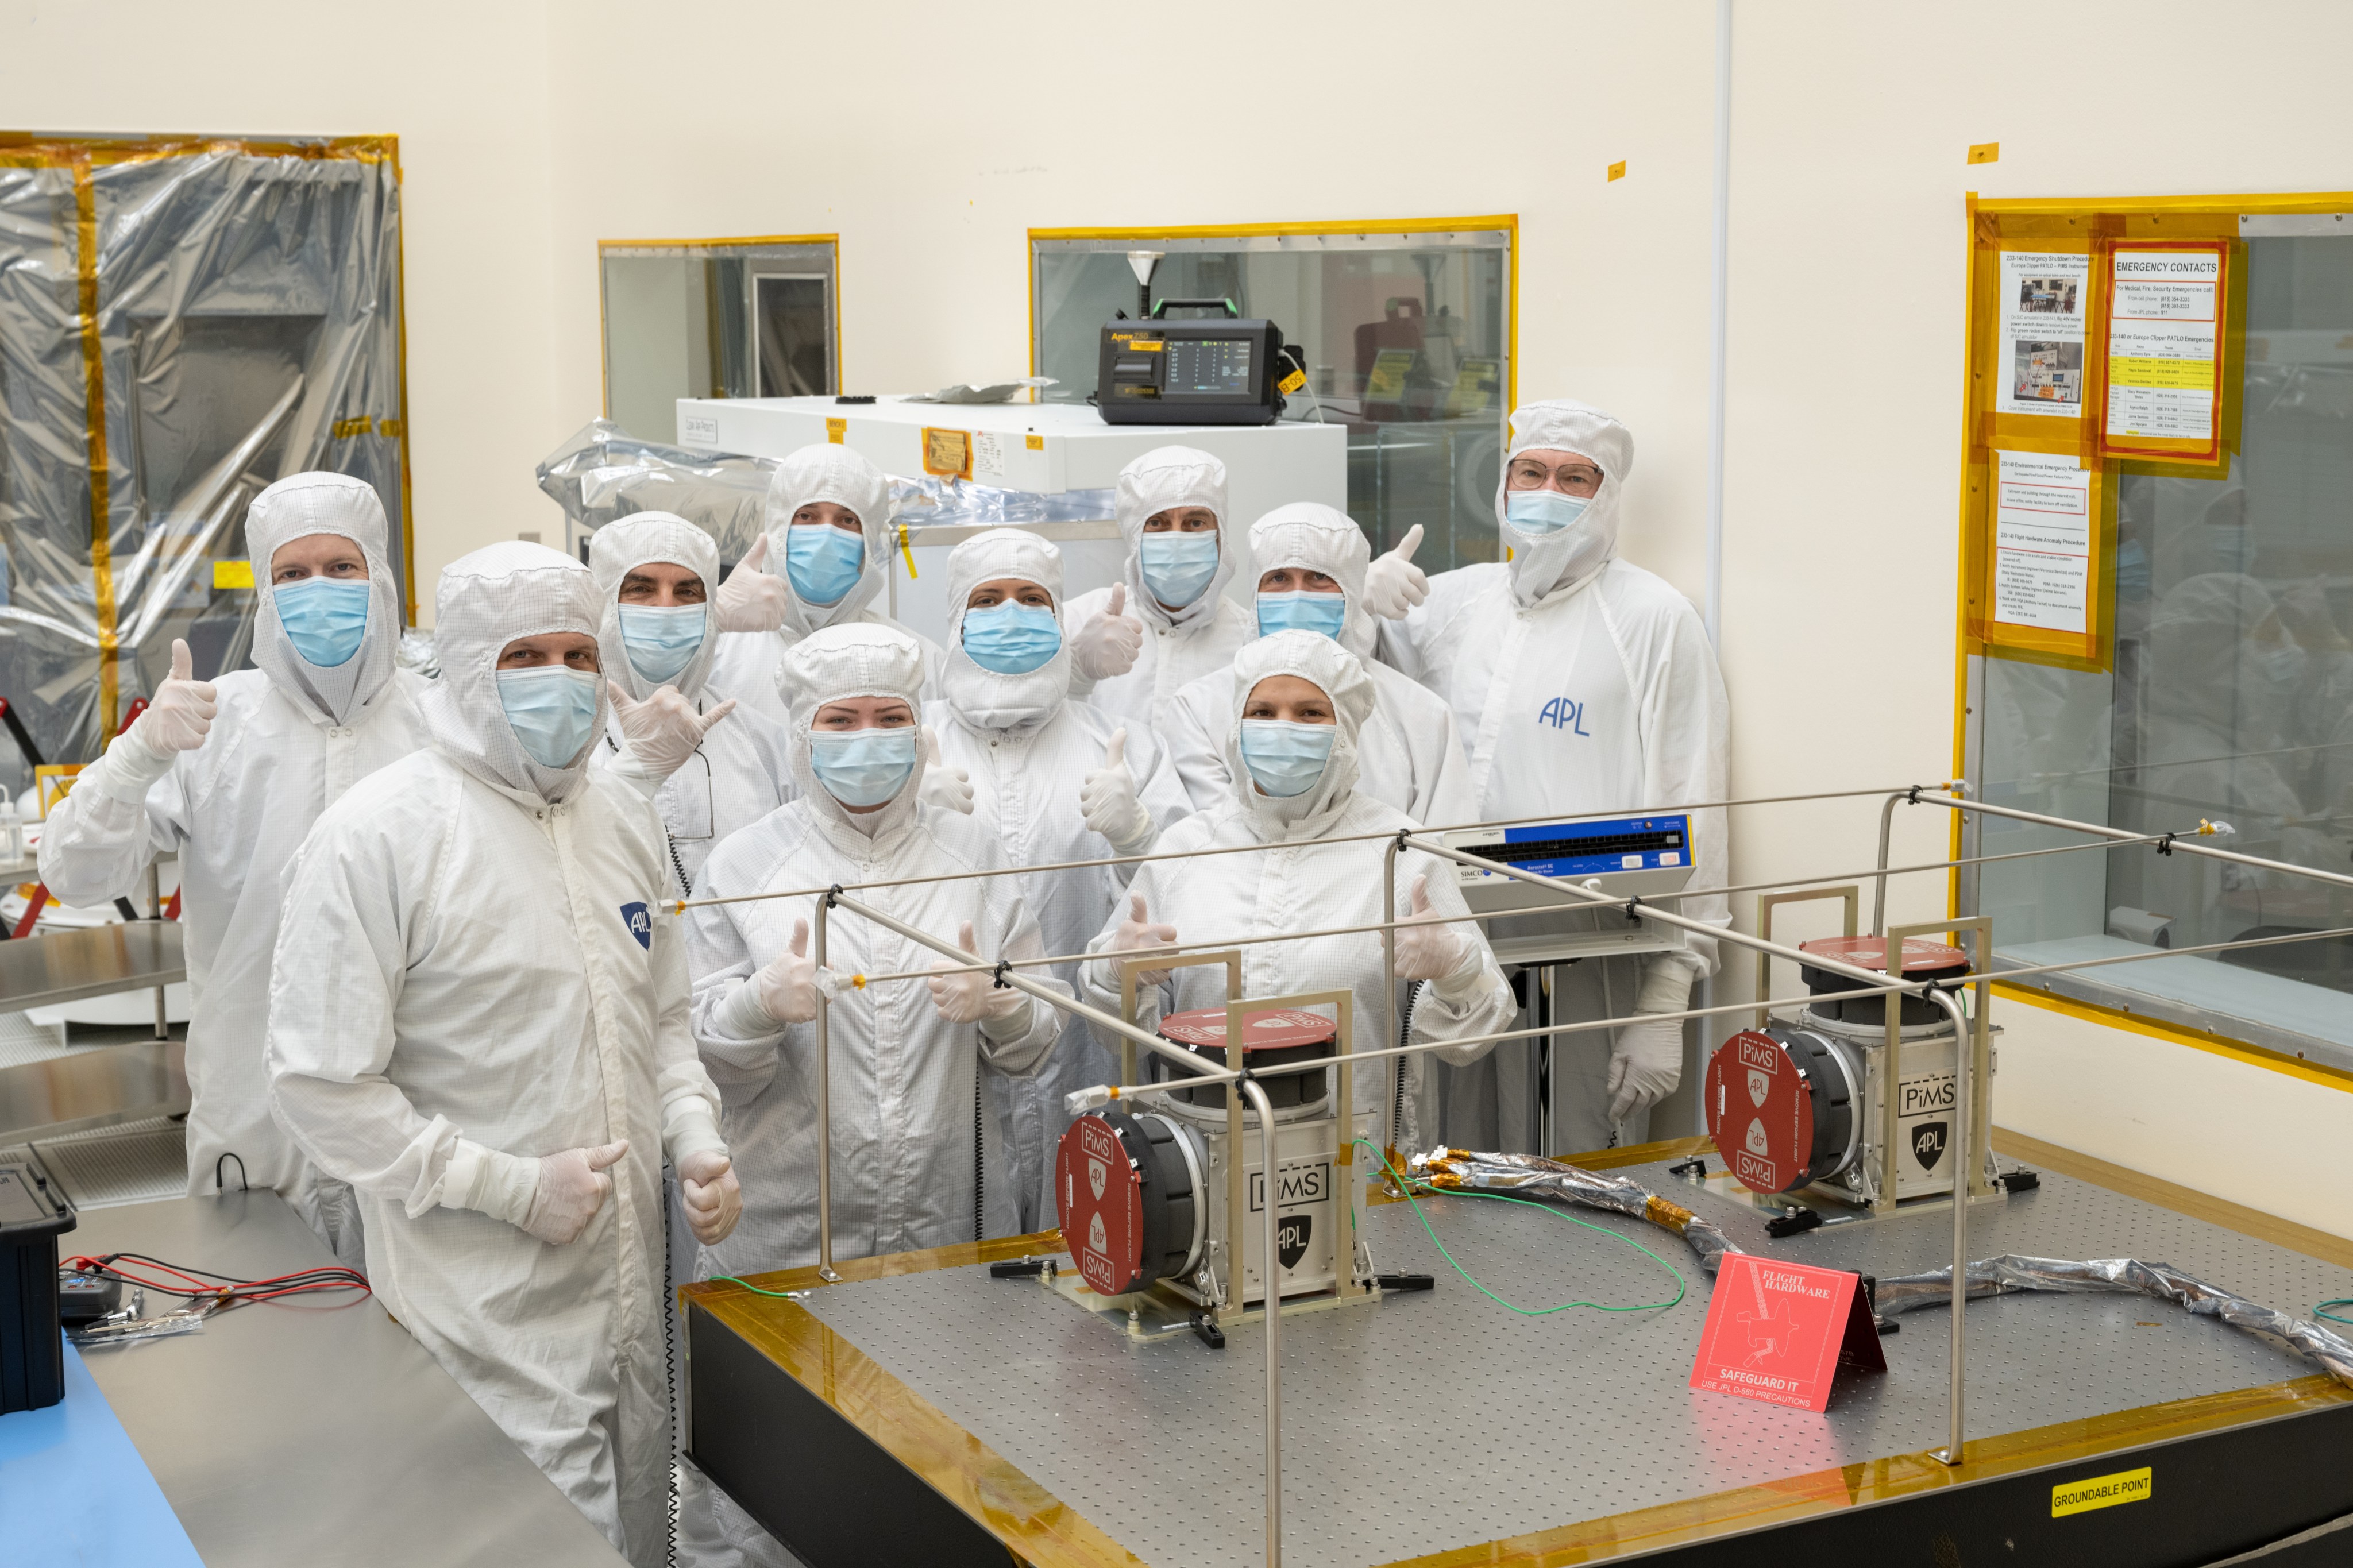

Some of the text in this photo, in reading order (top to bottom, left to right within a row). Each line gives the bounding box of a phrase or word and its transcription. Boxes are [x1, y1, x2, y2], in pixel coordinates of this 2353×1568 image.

[2117, 262, 2216, 272] EMERGENCY CONTACTS
[1111, 333, 1133, 343] Apex
[1281, 374, 1303, 393] 50-B
[2045, 464, 2067, 472] Emergency
[2043, 537, 2061, 545] Anomaly
[1538, 697, 1590, 737] APL
[1461, 869, 1483, 878] SIMCO
[631, 911, 650, 934] APL
[1743, 1042, 1773, 1068] PiMS
[1750, 1078, 1766, 1096] APL
[1906, 1083, 1954, 1110] PiMS
[1085, 1129, 1109, 1157] PiMS
[1749, 1129, 1765, 1147] APL
[1916, 1131, 1943, 1154] APL
[1091, 1168, 1104, 1187] APL
[1741, 1157, 1770, 1183] PiMS
[1091, 1225, 1104, 1244] APL
[1087, 1255, 1110, 1284] PiMS
[1762, 1270, 1805, 1285] FLIGHT
[1765, 1280, 1830, 1299] HARDWARE
[1719, 1368, 1799, 1392] SAFEGUARD IT
[1701, 1380, 1811, 1408] USE JPL D-560 PRECAUTIONS
[2054, 1477, 2149, 1507] GROUNDABLE POINT
